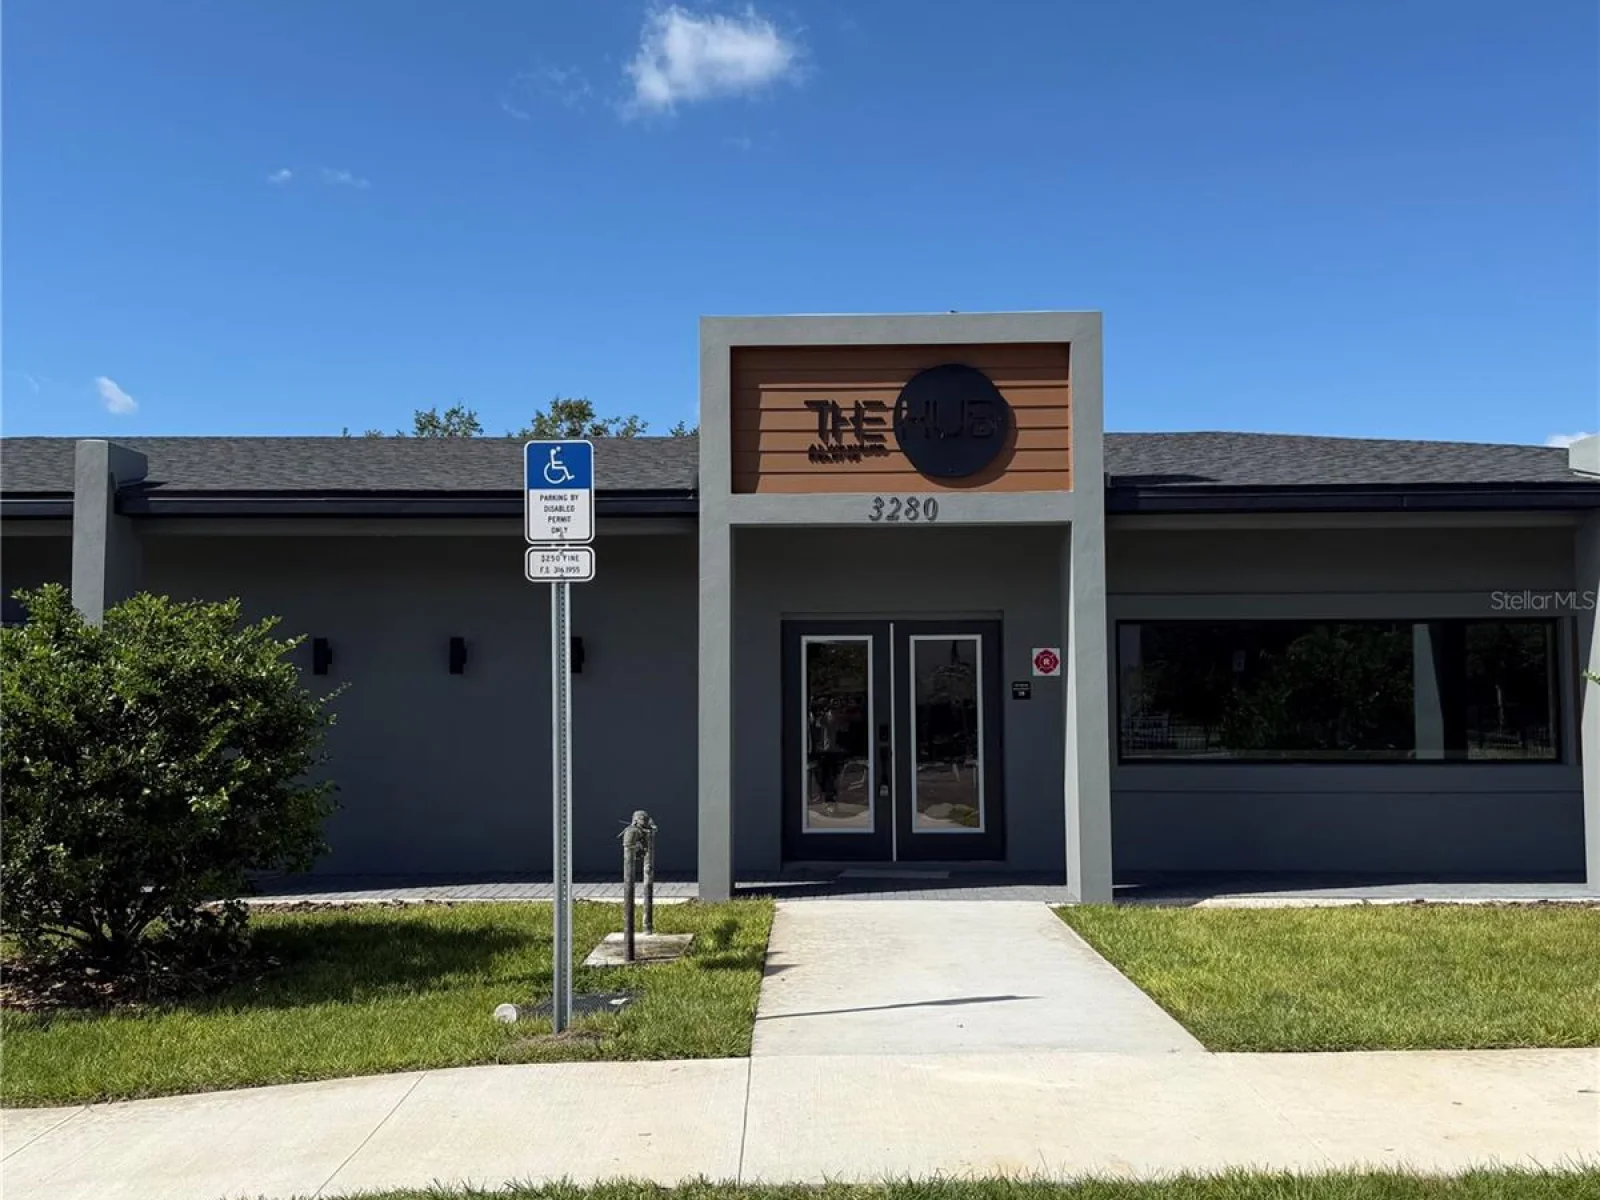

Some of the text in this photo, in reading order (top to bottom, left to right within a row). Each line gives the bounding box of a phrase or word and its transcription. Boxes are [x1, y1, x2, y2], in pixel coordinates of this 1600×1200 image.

[804, 399, 995, 445] THE HUB
[539, 494, 580, 502] PARKING BY
[543, 505, 575, 513] DISABLED
[868, 496, 939, 521] 3280
[551, 526, 568, 534] ONLY
[541, 554, 580, 563] $250 FINE
